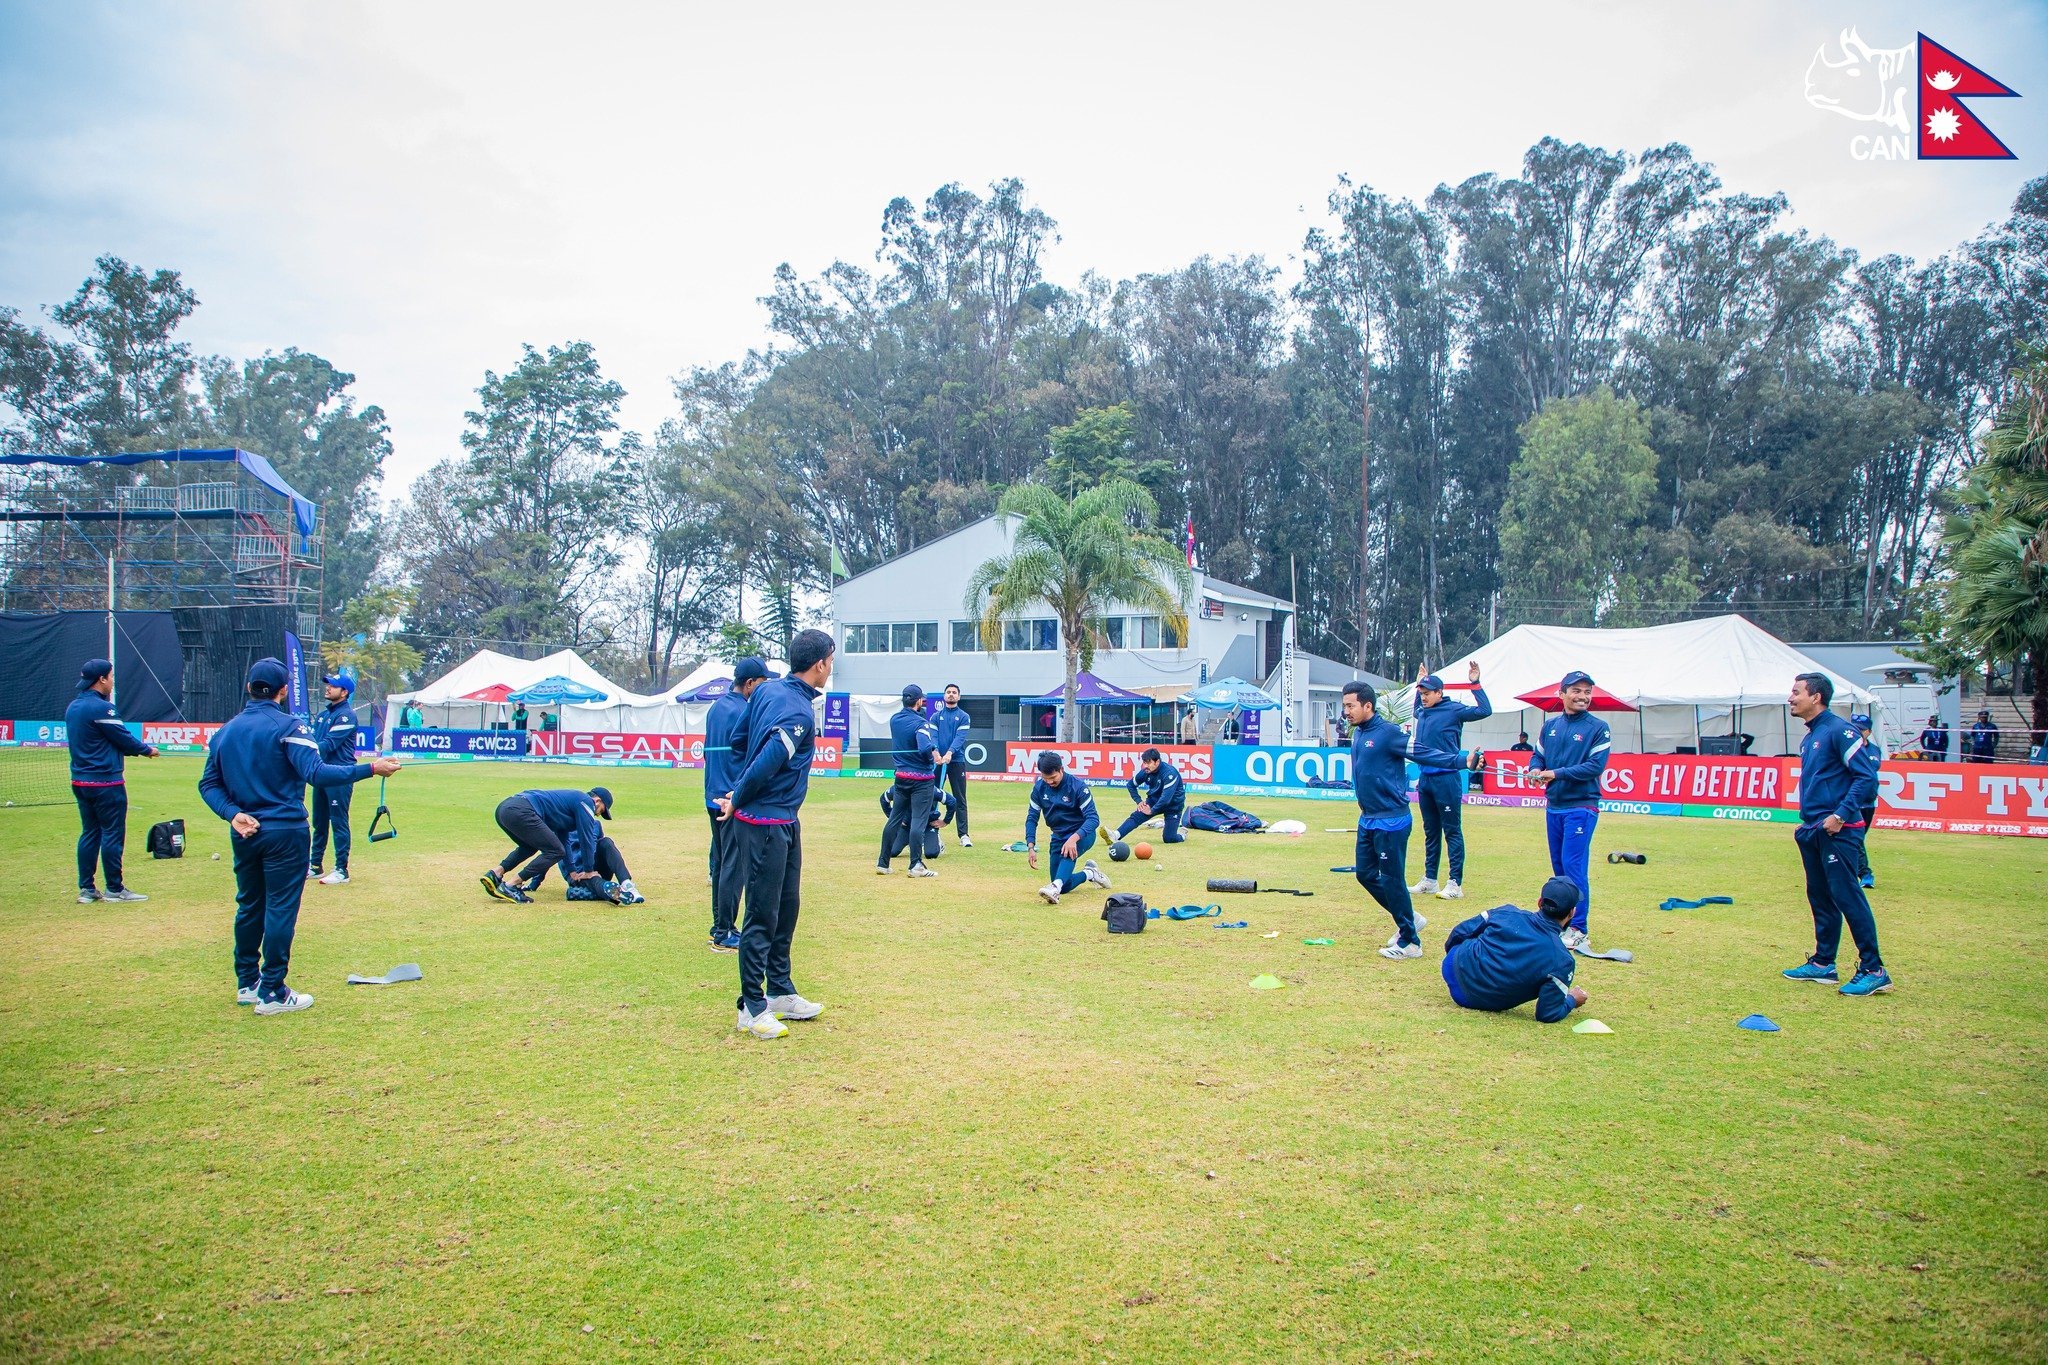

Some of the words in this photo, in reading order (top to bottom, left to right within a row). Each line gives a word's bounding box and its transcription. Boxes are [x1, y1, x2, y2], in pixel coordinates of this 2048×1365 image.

[144, 727, 200, 744] MRF
[401, 735, 451, 749] #CWC23
[468, 737, 517, 750] #CWC23
[531, 734, 684, 761] NISSAN
[1008, 749, 1101, 776] MRF
[1648, 764, 1687, 796] FLY
[1692, 766, 1778, 799] BETTER
[1476, 796, 1501, 805] BYJU'S
[1599, 801, 1650, 814] aramco
[1713, 807, 1772, 821] aramco
[1876, 818, 1909, 828] MRF
[1909, 819, 1942, 829] TYRES
[1949, 823, 1984, 832] MRF
[1985, 824, 2021, 834] TYRES
